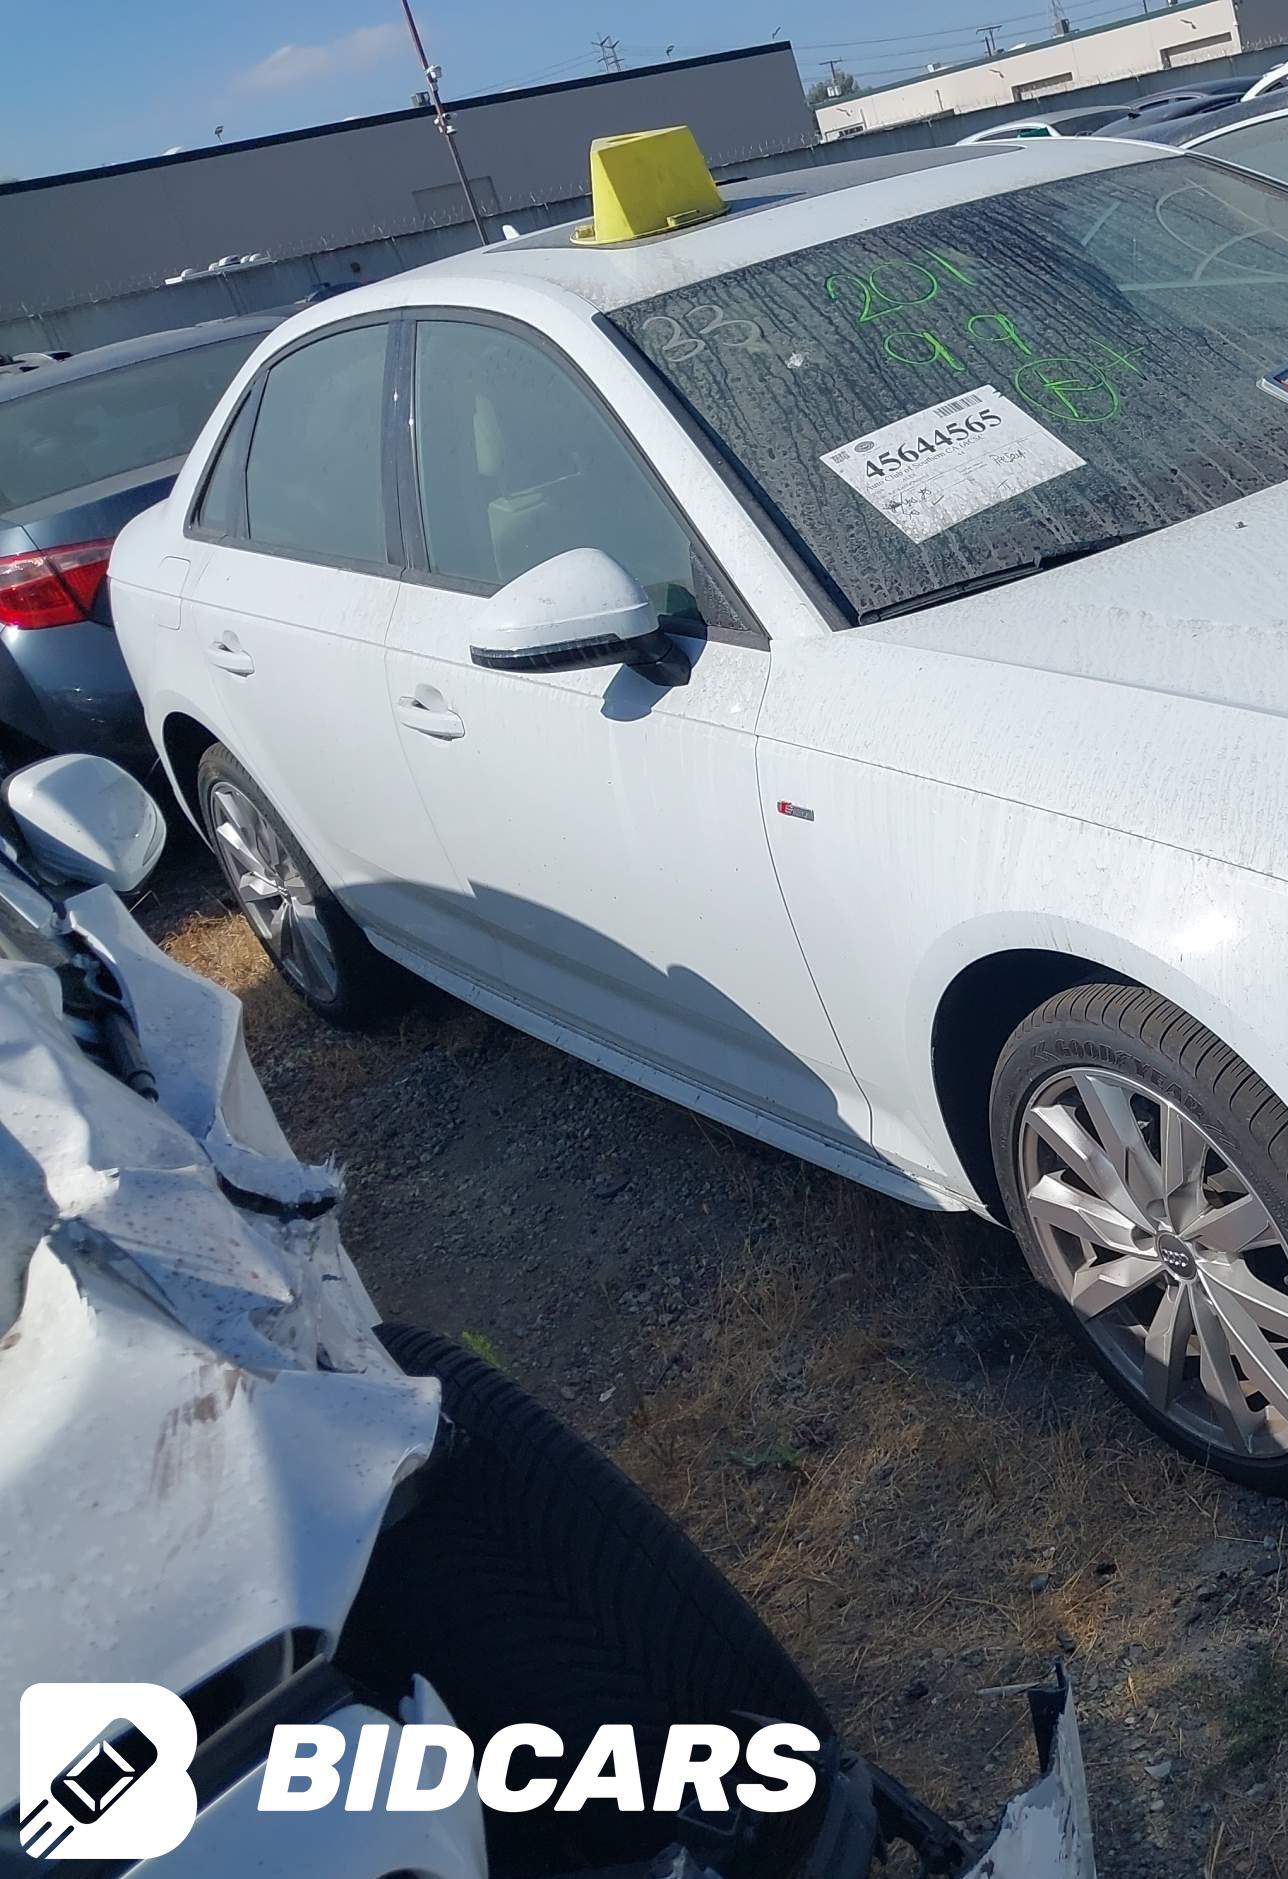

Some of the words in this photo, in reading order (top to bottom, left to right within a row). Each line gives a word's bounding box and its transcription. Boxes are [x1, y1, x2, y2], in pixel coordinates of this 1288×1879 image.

[825, 248, 977, 323] 201
[865, 409, 1002, 478] 45644565
[867, 480, 885, 492] Auto
[885, 469, 905, 482] Club
[905, 465, 914, 475] of
[912, 451, 946, 468] Southern
[1055, 1038, 1204, 1117] GOODYEAR
